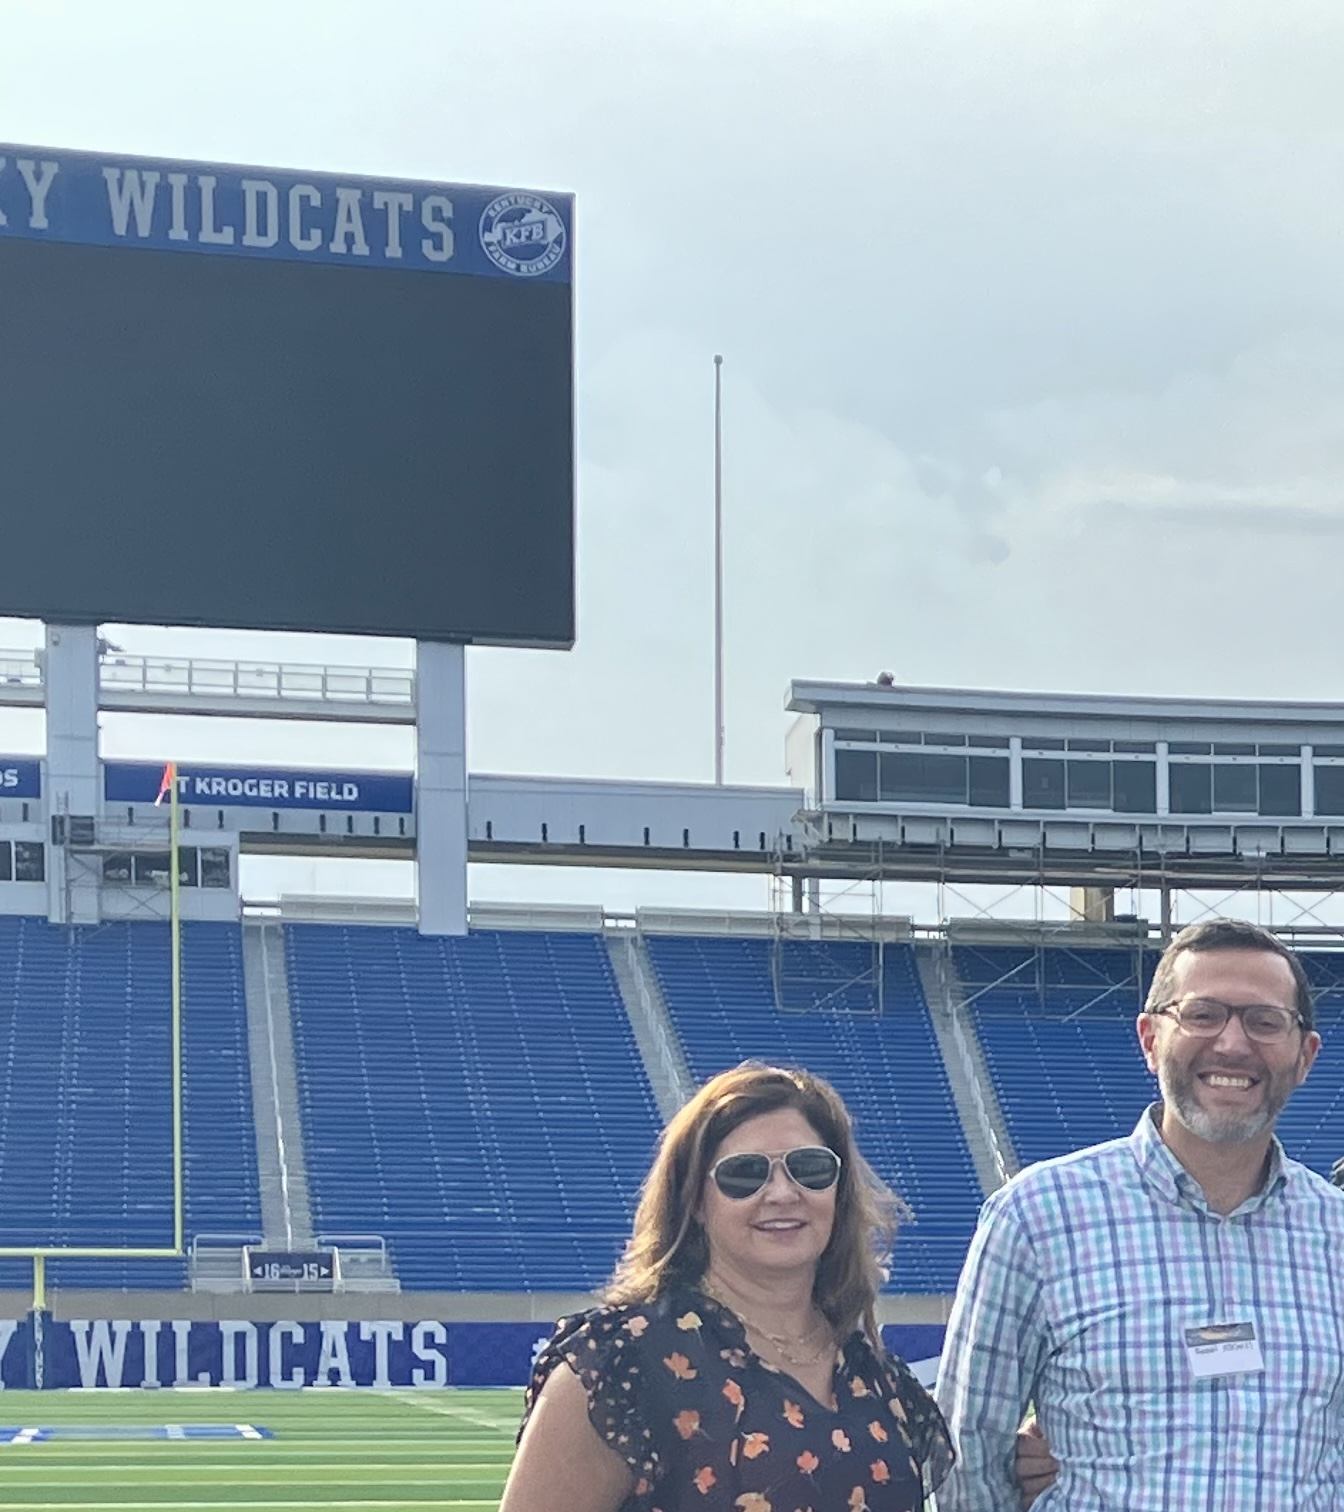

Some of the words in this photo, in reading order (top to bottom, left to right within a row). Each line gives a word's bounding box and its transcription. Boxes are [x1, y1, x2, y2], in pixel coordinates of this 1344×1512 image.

[102, 166, 454, 262] WILDCATS
[504, 222, 544, 246] KFB
[195, 776, 289, 799] KROGER
[294, 780, 359, 802] FIELD
[264, 1263, 280, 1281] 16
[302, 1263, 319, 1281] 15
[69, 1319, 450, 1389] WILDCATS
